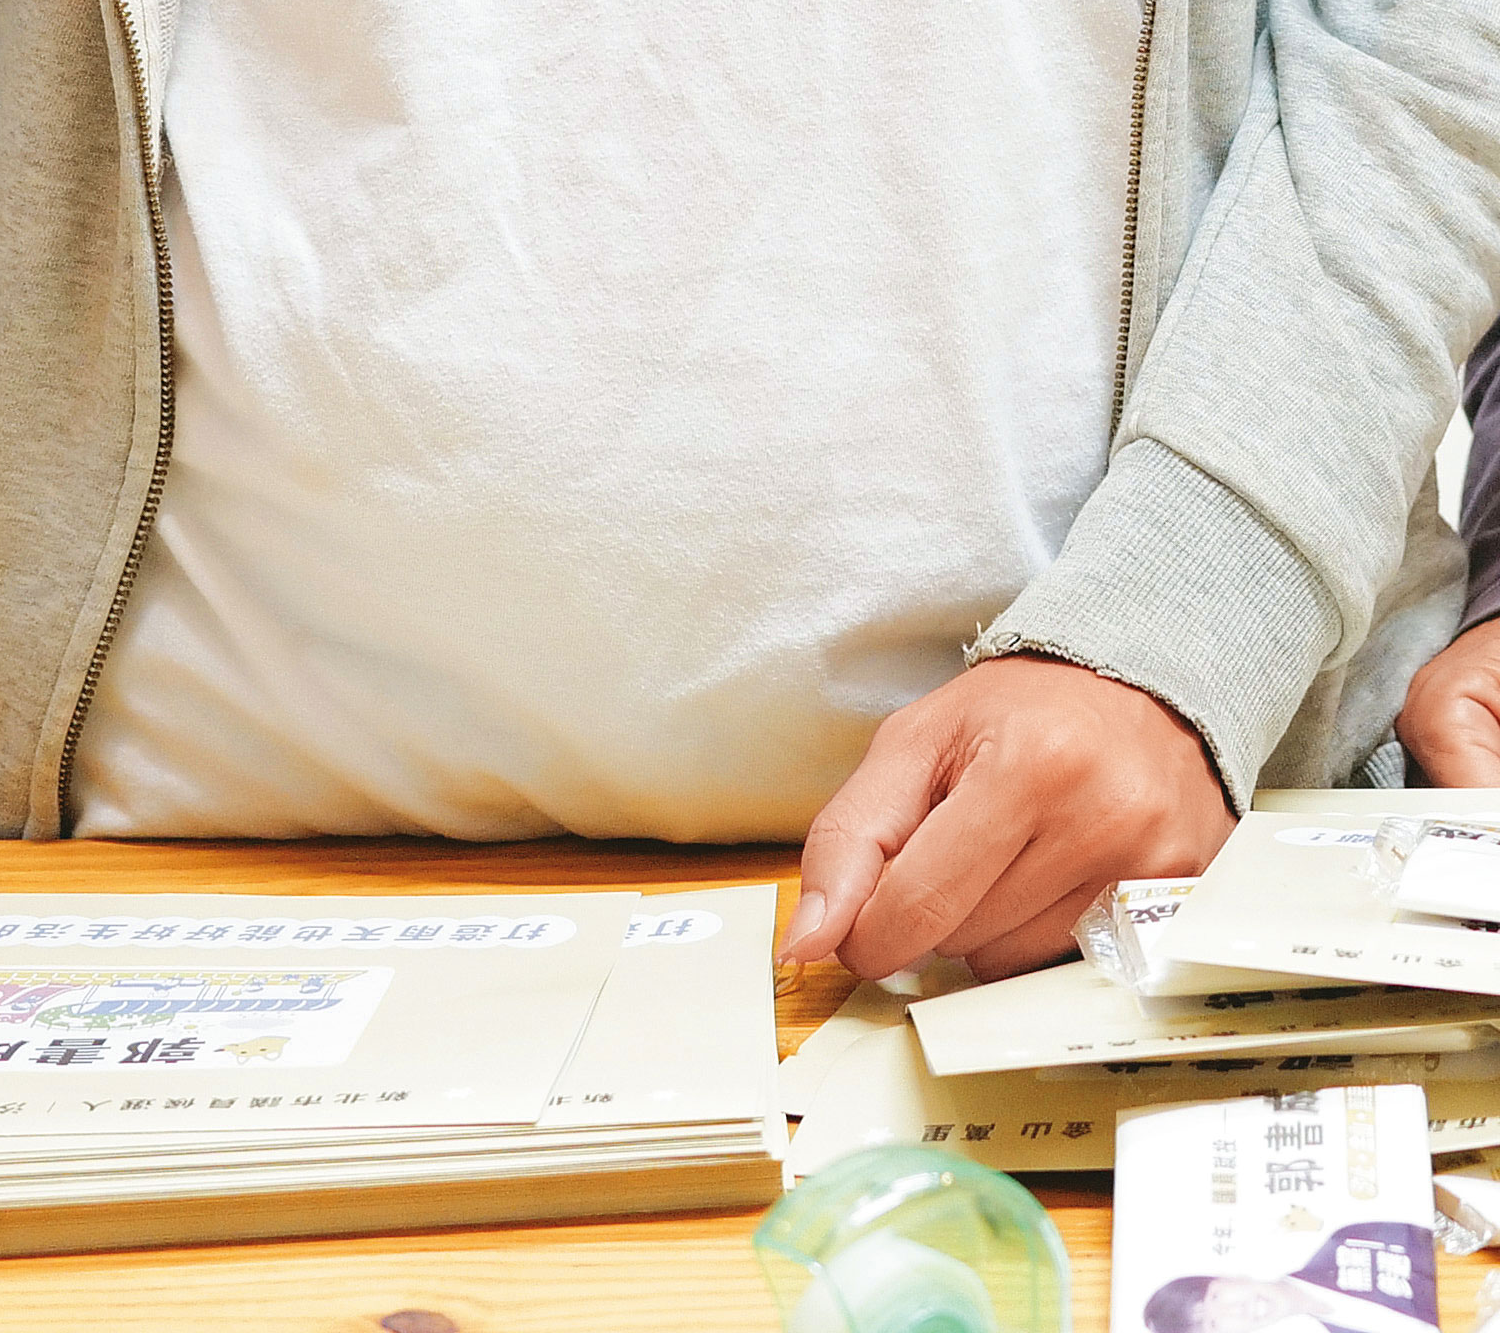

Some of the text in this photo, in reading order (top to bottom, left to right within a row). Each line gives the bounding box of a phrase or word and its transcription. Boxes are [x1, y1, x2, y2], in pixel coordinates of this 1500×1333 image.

[80, 1090, 409, 1115] 新北市議員候選人
[920, 1119, 1095, 1142] 金山 萬里
